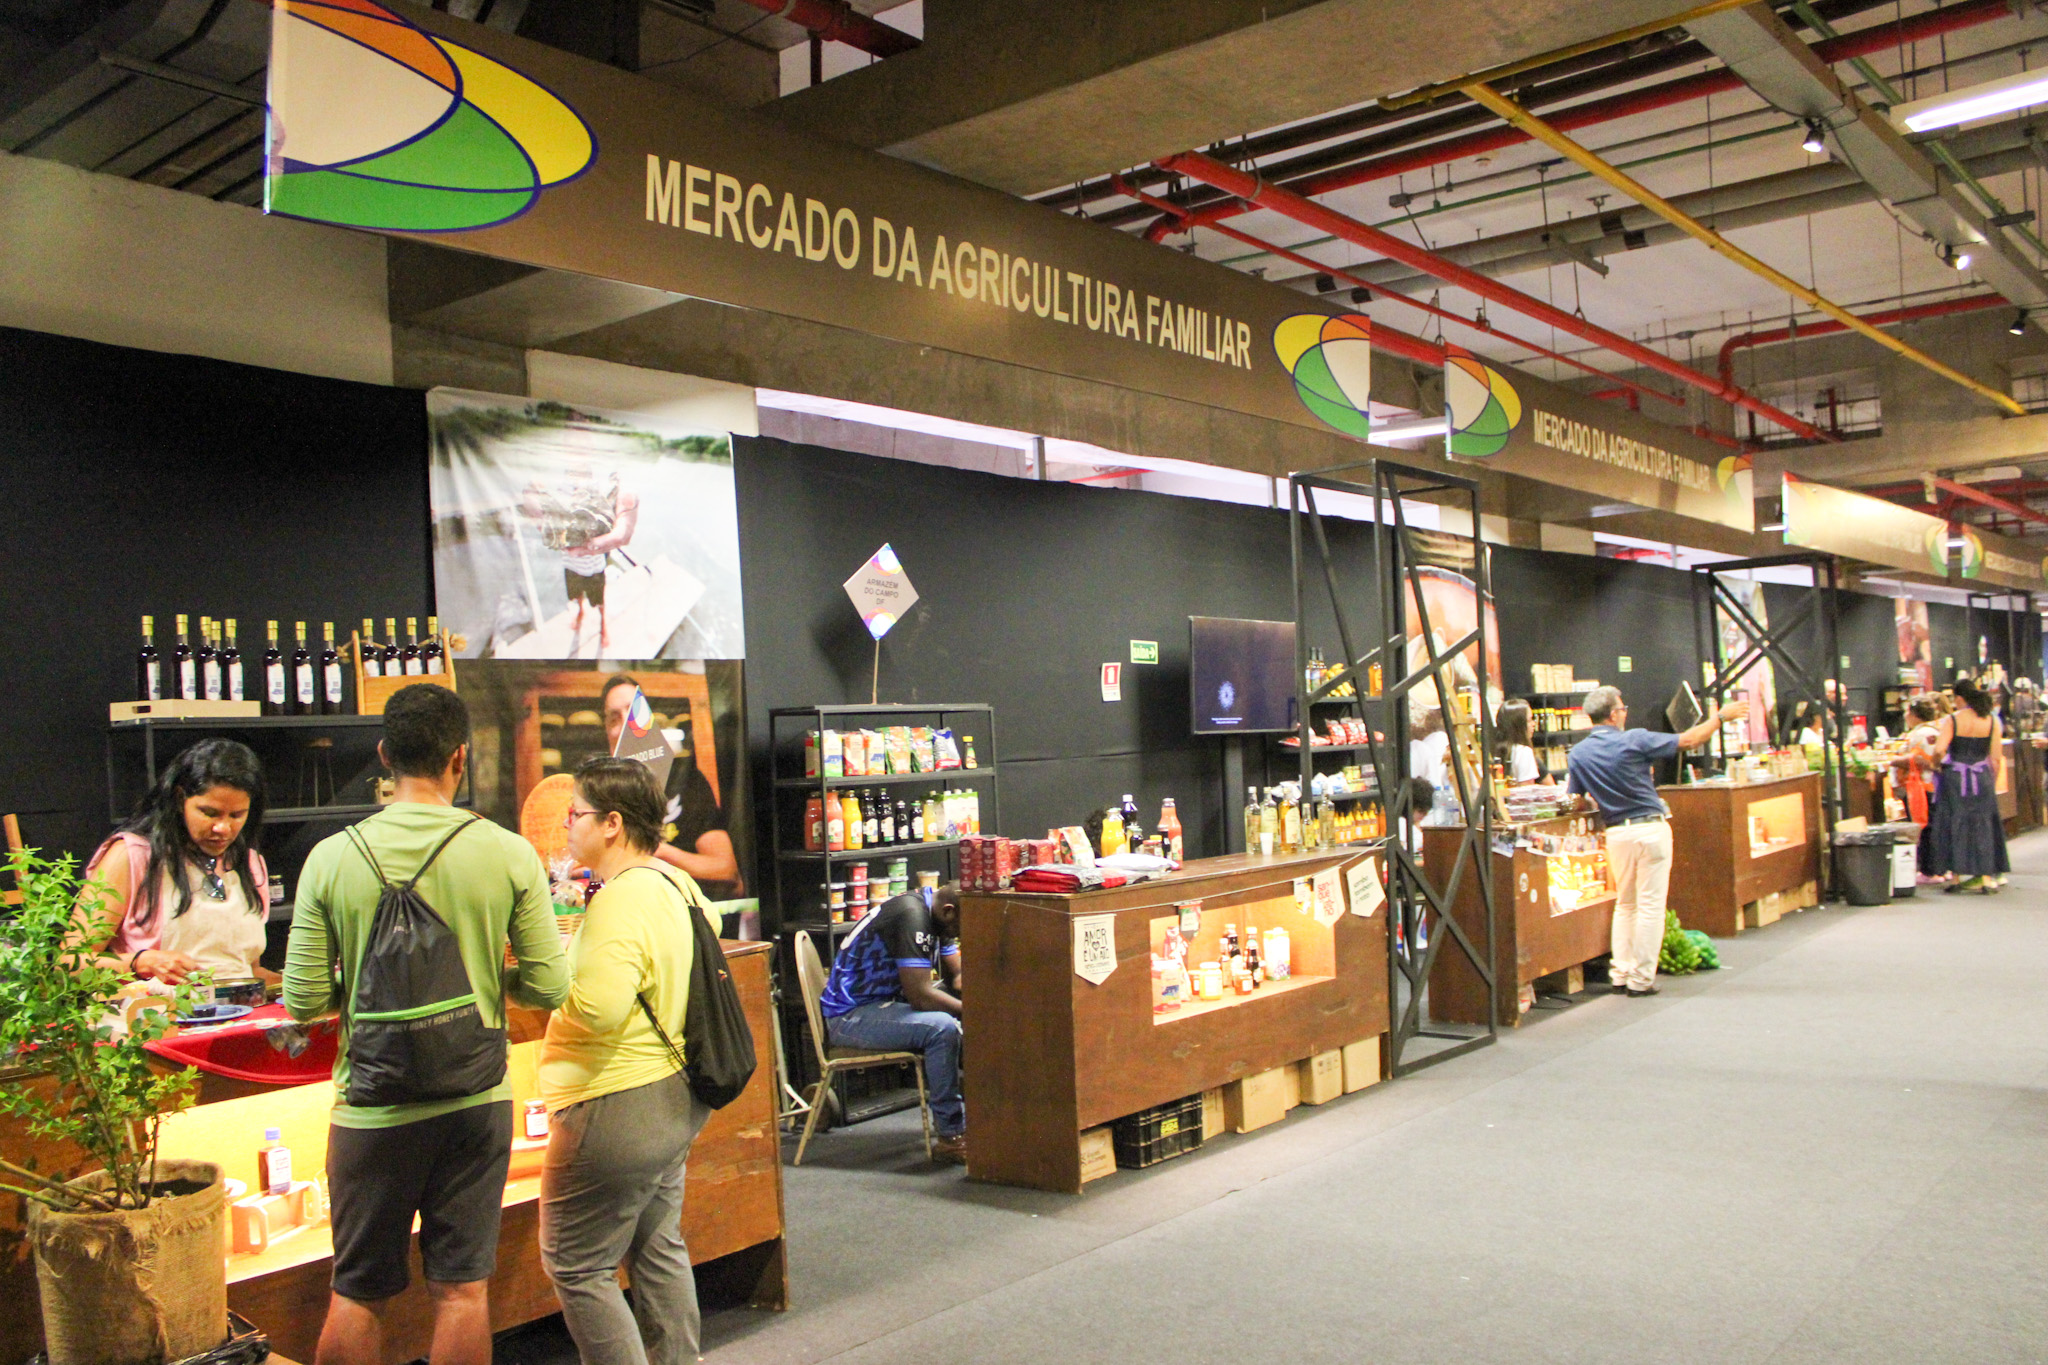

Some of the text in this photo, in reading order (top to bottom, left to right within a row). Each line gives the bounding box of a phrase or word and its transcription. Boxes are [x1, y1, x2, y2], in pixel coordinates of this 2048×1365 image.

[646, 153, 1252, 370] MERCADO DA AGRICULTURA FAMILIAR
[1534, 409, 1711, 492] MERCADO DA AGRICULTURA FAMILIAR
[864, 587, 899, 598] DO CAMPO
[649, 746, 664, 760] BLUE
